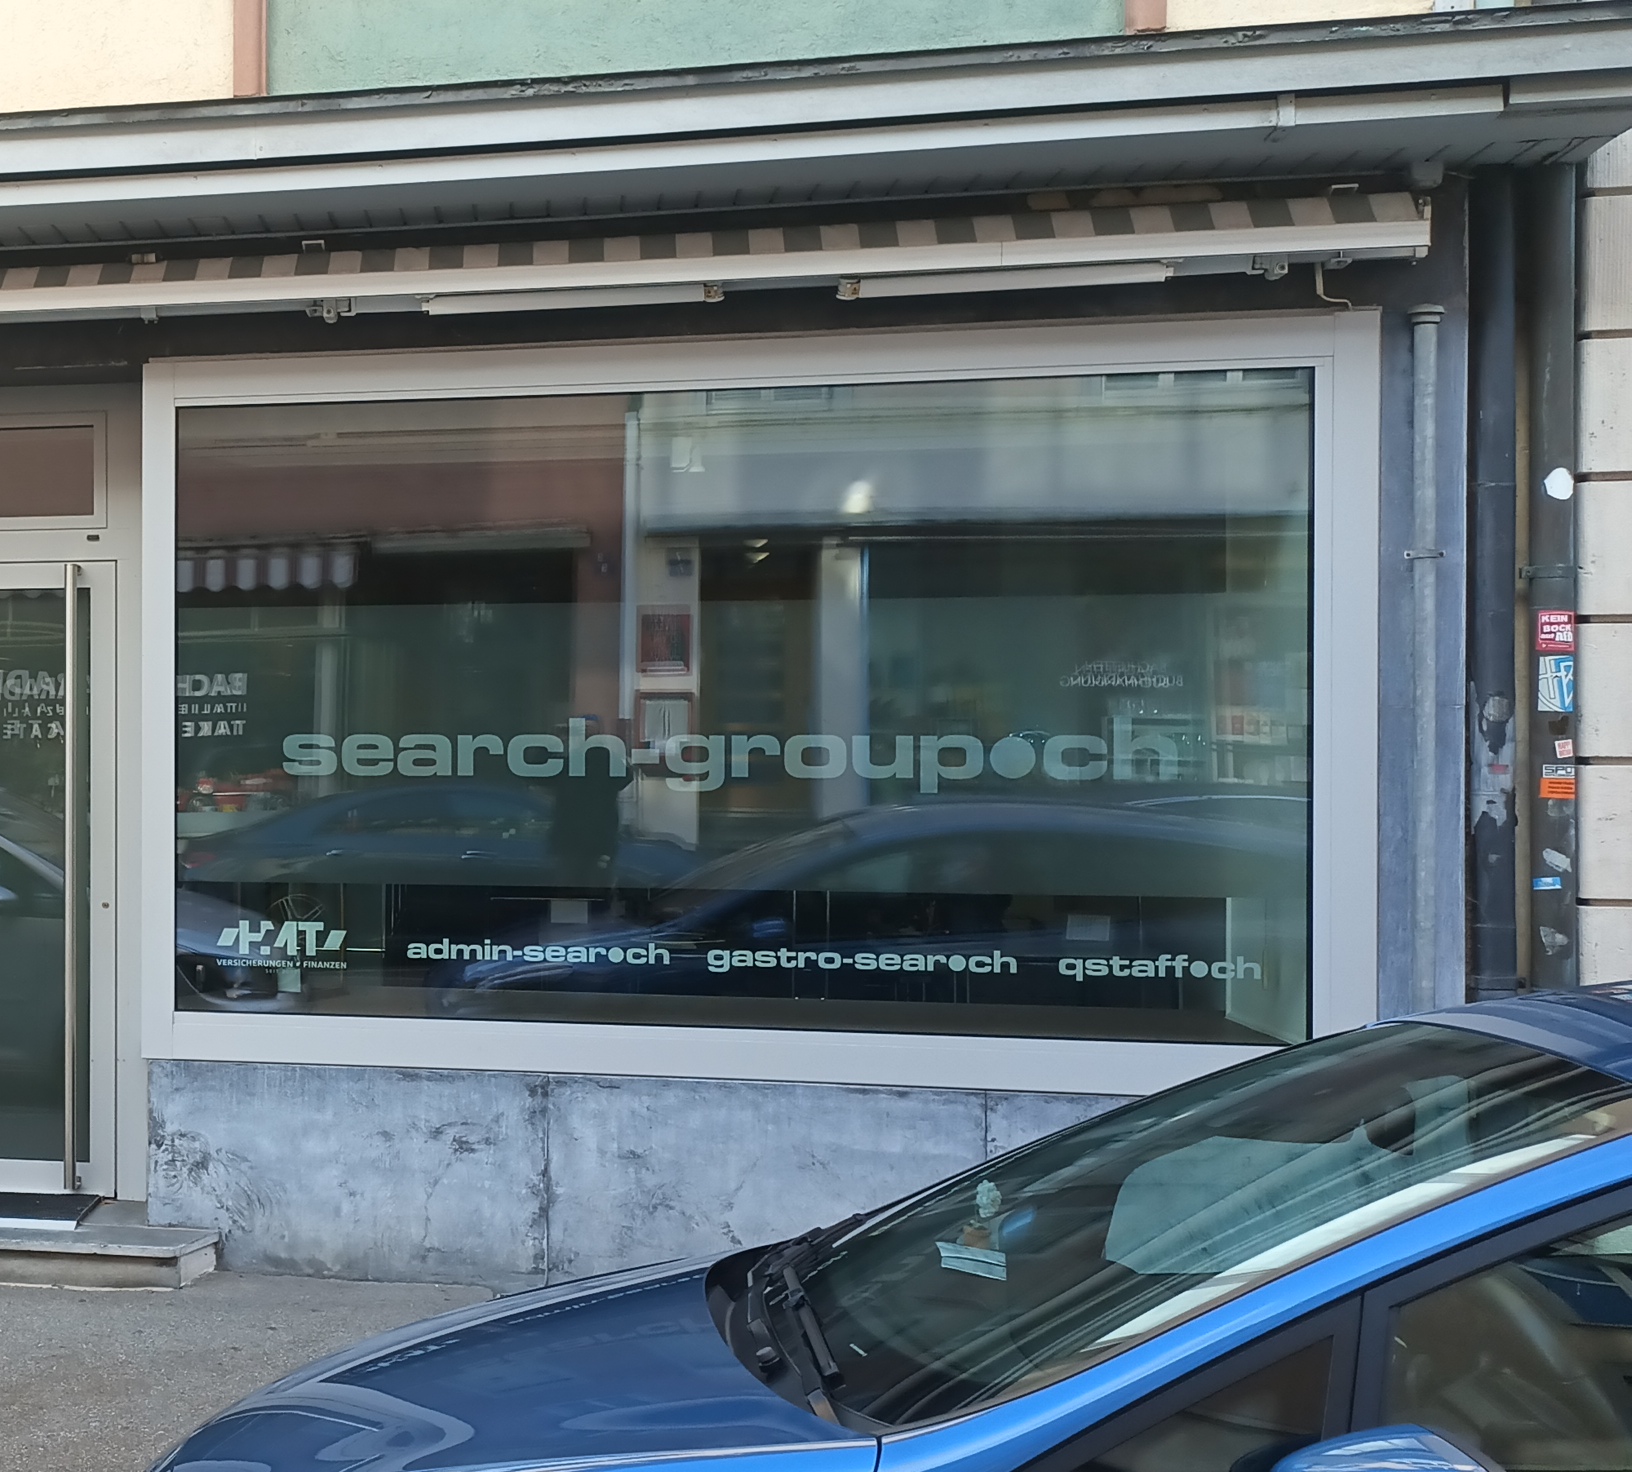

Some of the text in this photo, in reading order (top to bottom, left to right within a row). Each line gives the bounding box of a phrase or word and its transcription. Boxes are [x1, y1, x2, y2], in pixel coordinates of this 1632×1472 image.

[1543, 624, 1572, 632] BOCK
[216, 958, 347, 969] VERSICHERUNGEN FINANZEN
